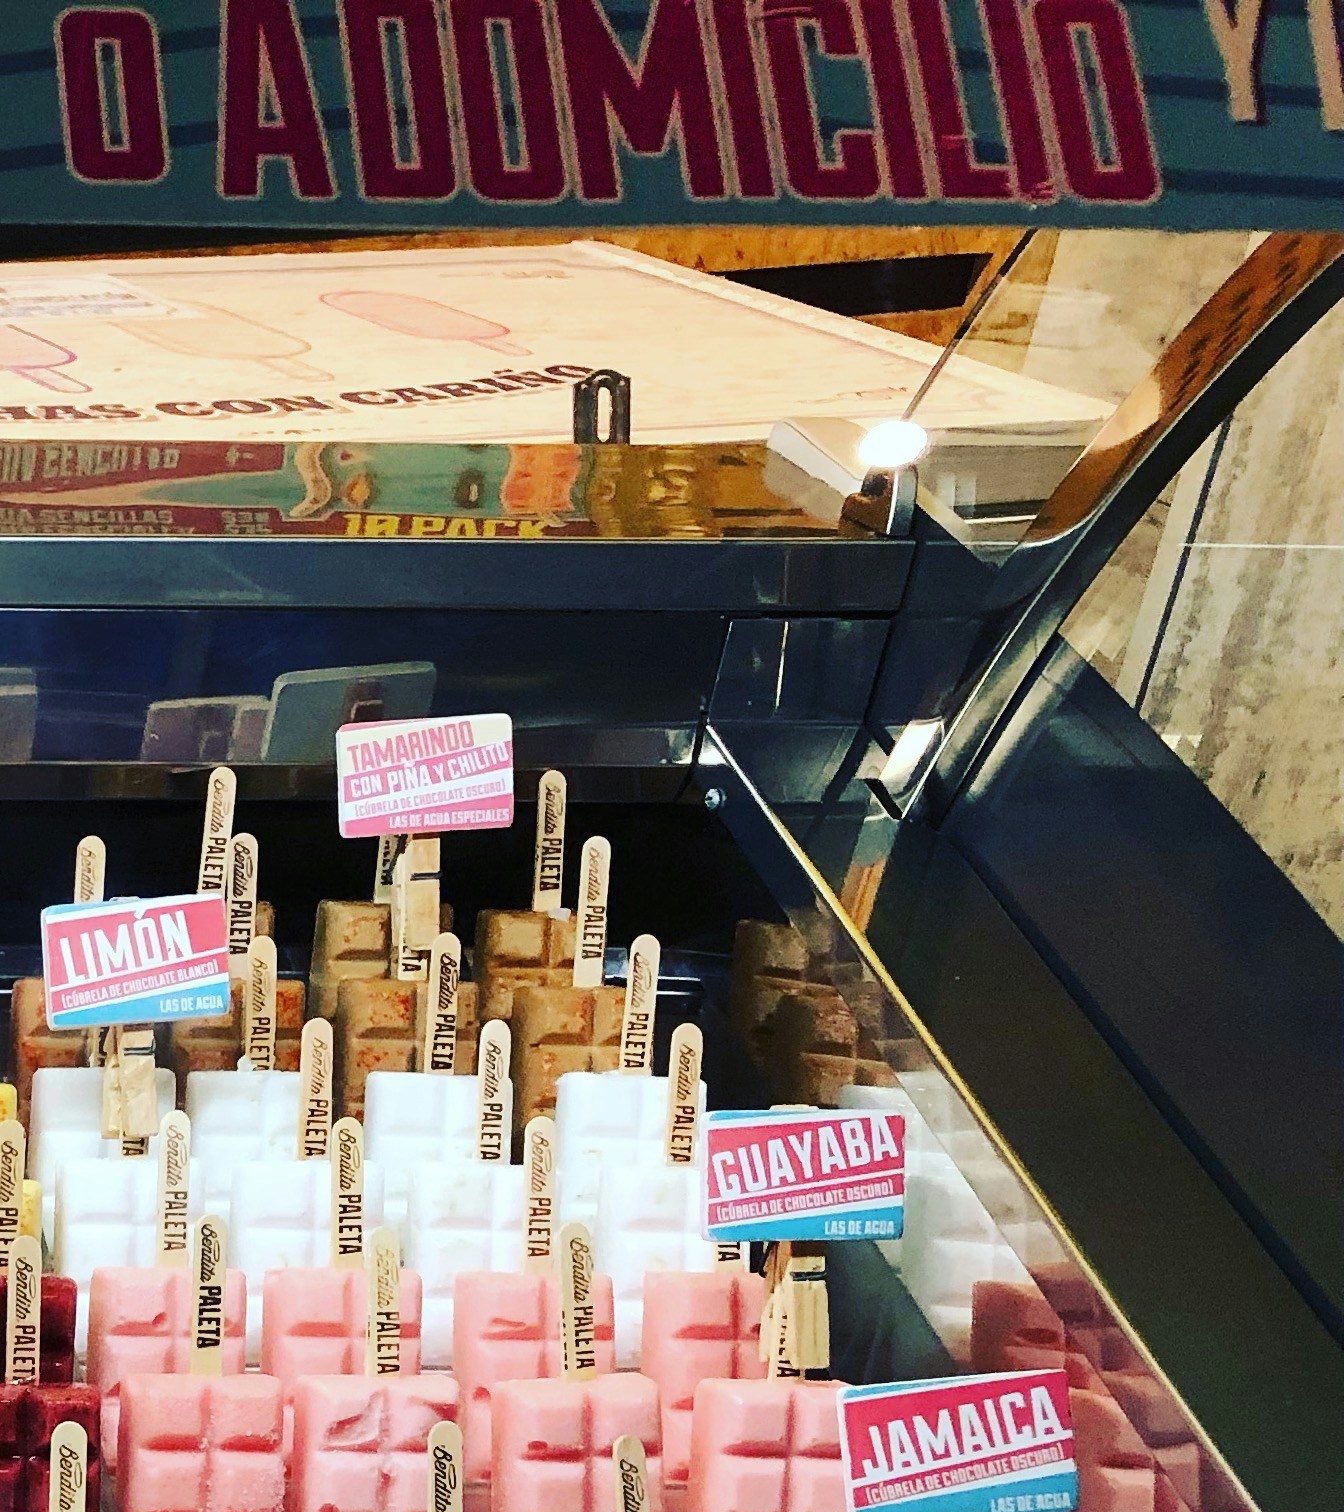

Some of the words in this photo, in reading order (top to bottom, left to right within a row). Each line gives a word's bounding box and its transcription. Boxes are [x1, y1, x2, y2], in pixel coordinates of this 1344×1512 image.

[53, 5, 171, 184] O
[156, 394, 332, 418] CON
[341, 364, 595, 407] CARIÑO
[347, 720, 474, 772] TAMARINDO
[350, 774, 382, 798] CON
[387, 759, 431, 793] PIÑA
[433, 762, 444, 780] Y
[447, 741, 510, 780] CHILITO
[204, 838, 228, 891] PALETA
[542, 838, 563, 892] PALETA
[60, 908, 193, 985] LIMÓN
[160, 997, 179, 1012] LAS
[181, 997, 194, 1011] DE
[196, 995, 223, 1009] AGUA
[712, 1114, 899, 1198] GUAYABA
[530, 1197, 551, 1256] PALETA
[770, 1200, 784, 1214] DE
[785, 1189, 845, 1211] CHOCOLATE
[824, 1220, 846, 1235] LAS
[848, 1220, 862, 1235] DE
[865, 1220, 895, 1235] AGUA
[862, 1385, 1064, 1477] JAMAICA
[927, 1474, 942, 1491] DE
[944, 1461, 1011, 1487] CHOCOLATE
[1017, 1495, 1034, 1512] DE
[1036, 1492, 1071, 1510] AGUA
